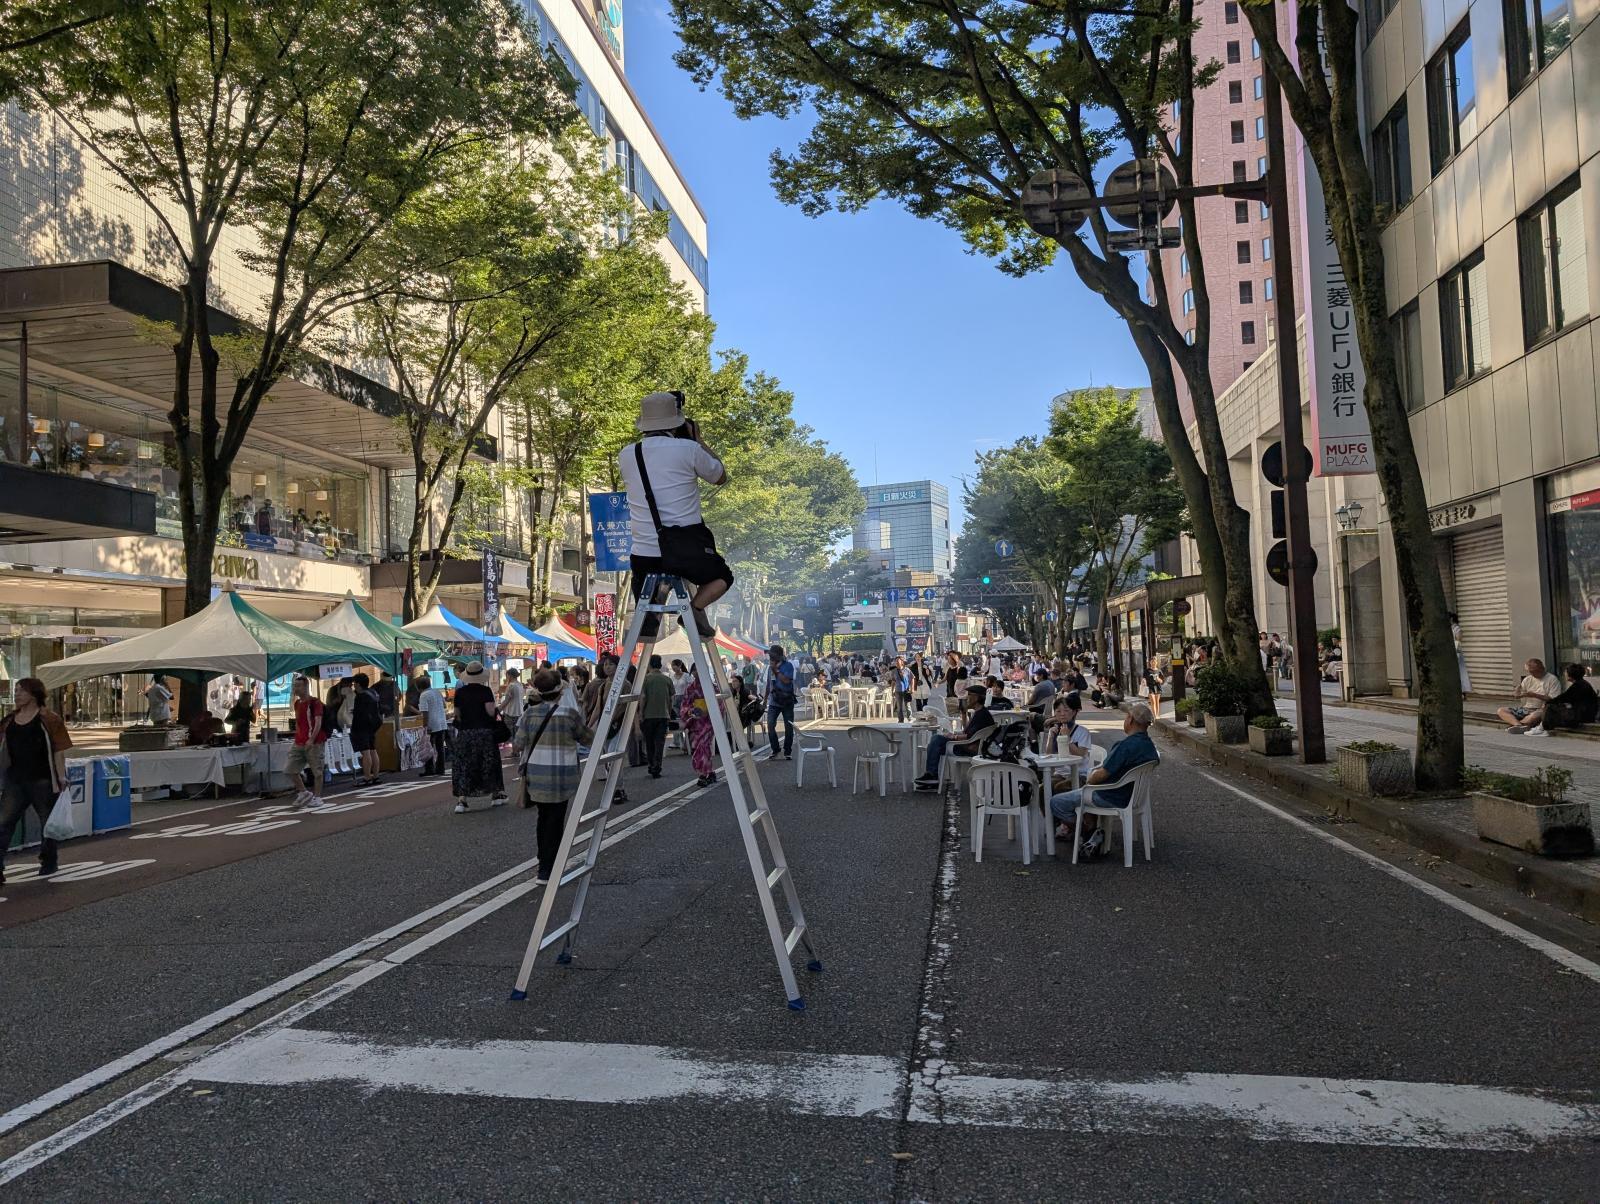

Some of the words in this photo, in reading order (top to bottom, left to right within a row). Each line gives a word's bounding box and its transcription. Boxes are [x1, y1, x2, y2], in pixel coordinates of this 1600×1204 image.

[1326, 264, 1357, 417] 三菱UFJ銀行
[1325, 443, 1367, 456] MUFG
[1326, 454, 1369, 467] PLAZA
